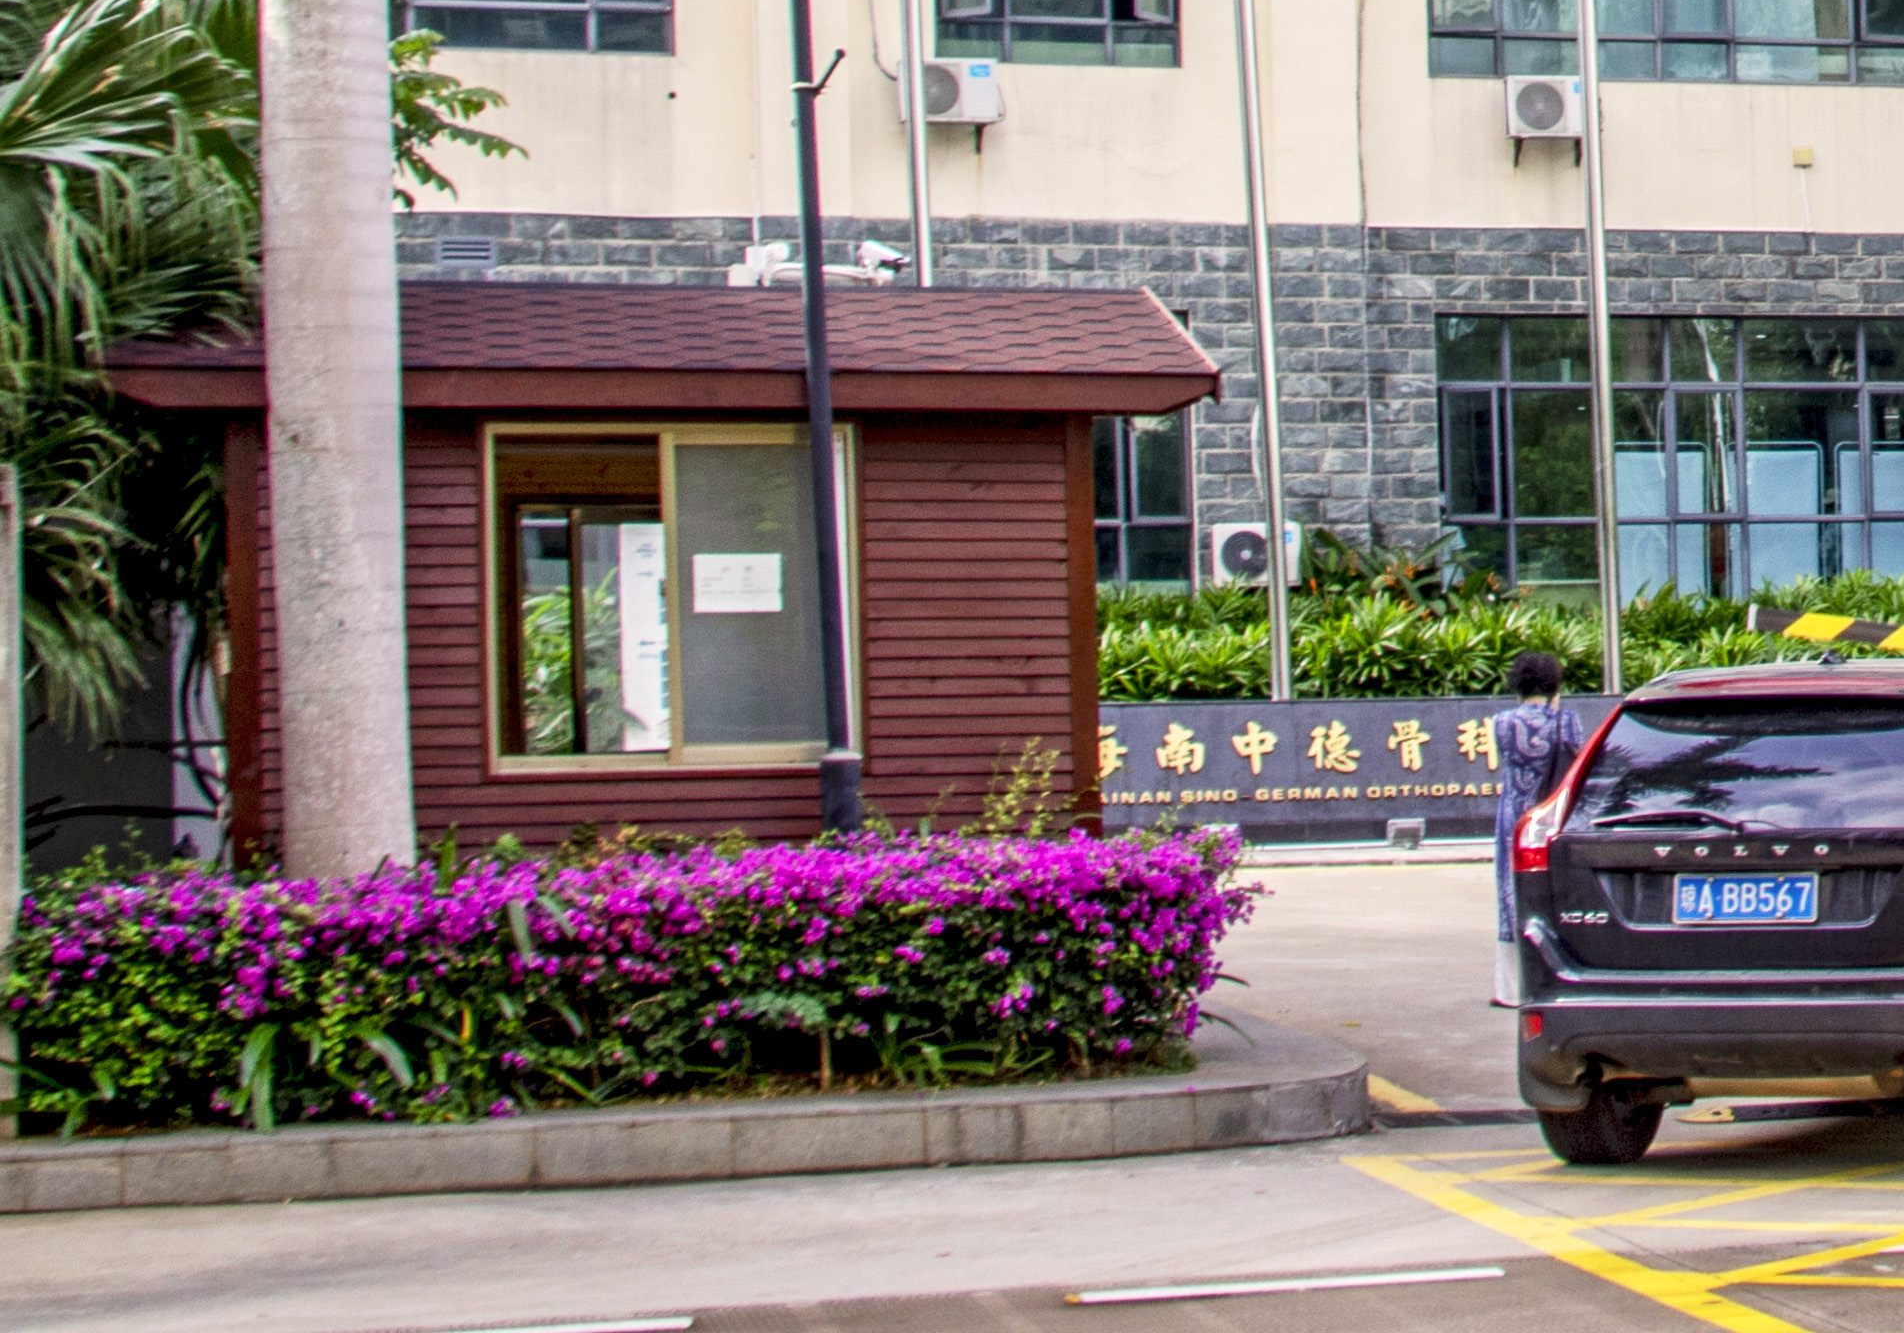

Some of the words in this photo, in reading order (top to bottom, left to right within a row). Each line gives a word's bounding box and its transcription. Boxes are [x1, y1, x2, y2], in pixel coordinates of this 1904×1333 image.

[1100, 790, 1172, 804] AINAN
[1652, 843, 1830, 857] VOLVO
[1559, 911, 1609, 924] XC60
